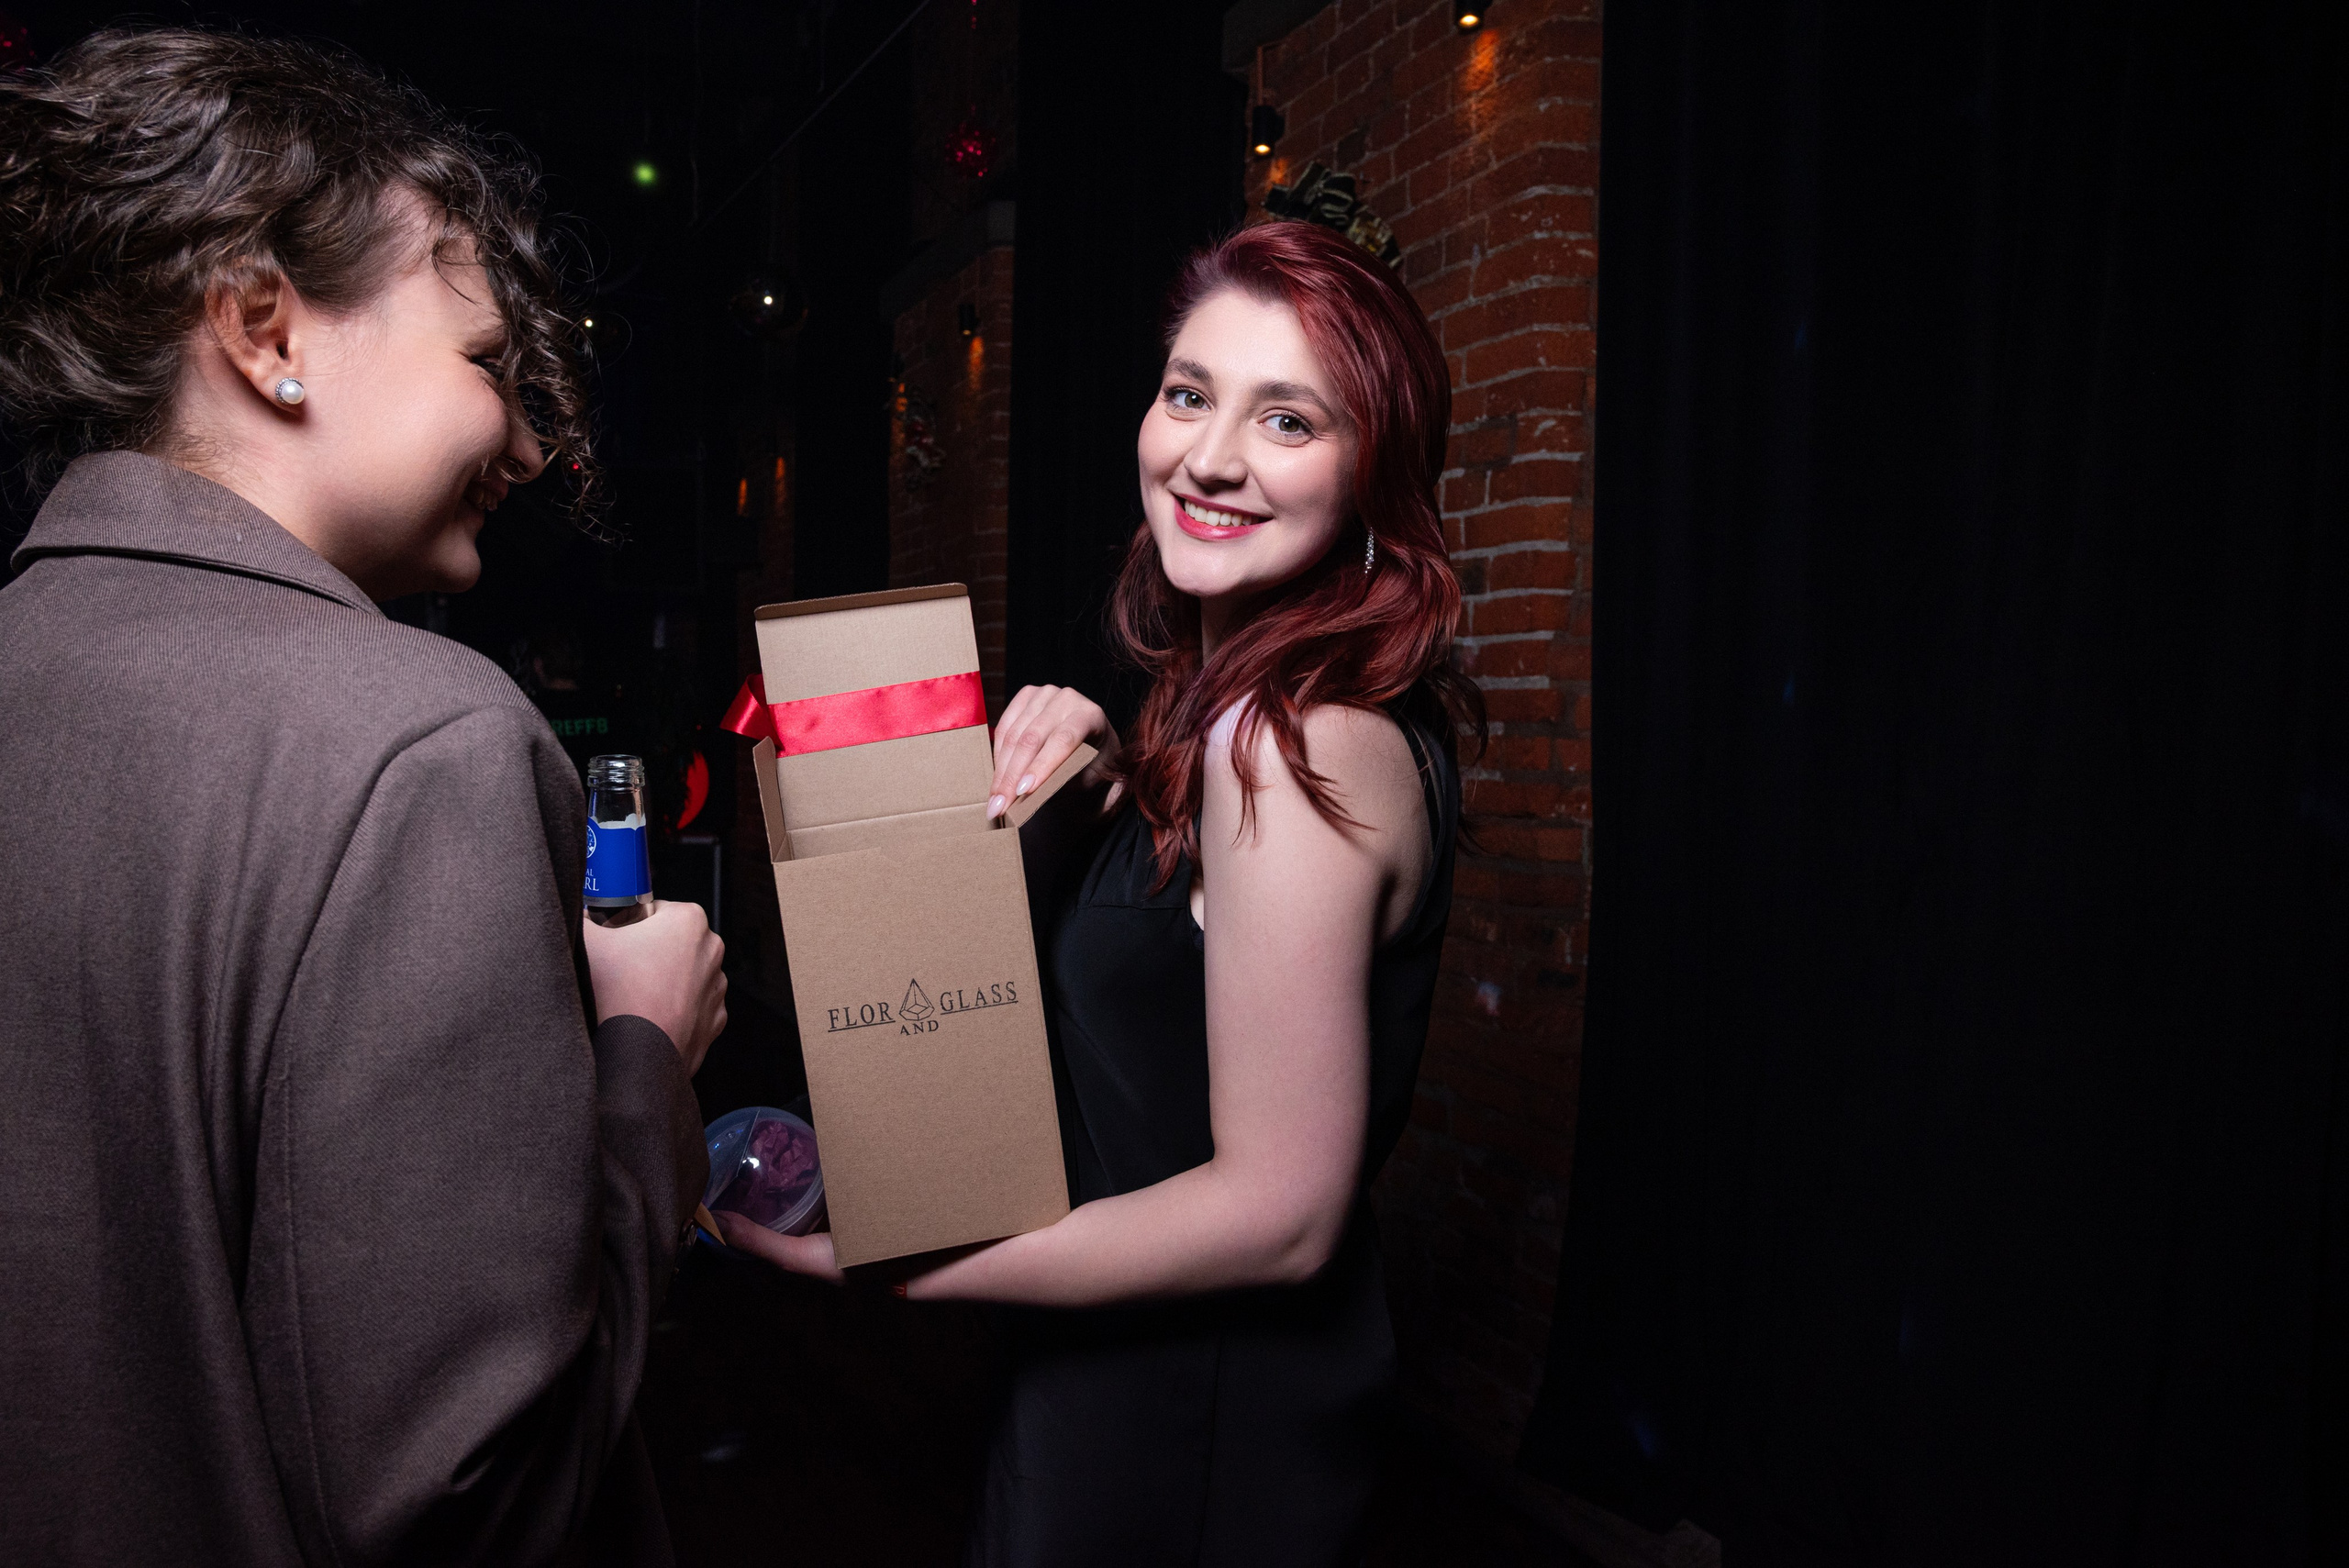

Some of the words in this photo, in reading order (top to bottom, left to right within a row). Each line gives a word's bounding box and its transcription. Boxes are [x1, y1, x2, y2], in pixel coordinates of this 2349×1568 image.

[584, 876, 599, 891] RL
[828, 1002, 894, 1029] FLOR
[940, 981, 1018, 1012] GLASS
[899, 1019, 940, 1036] AND
